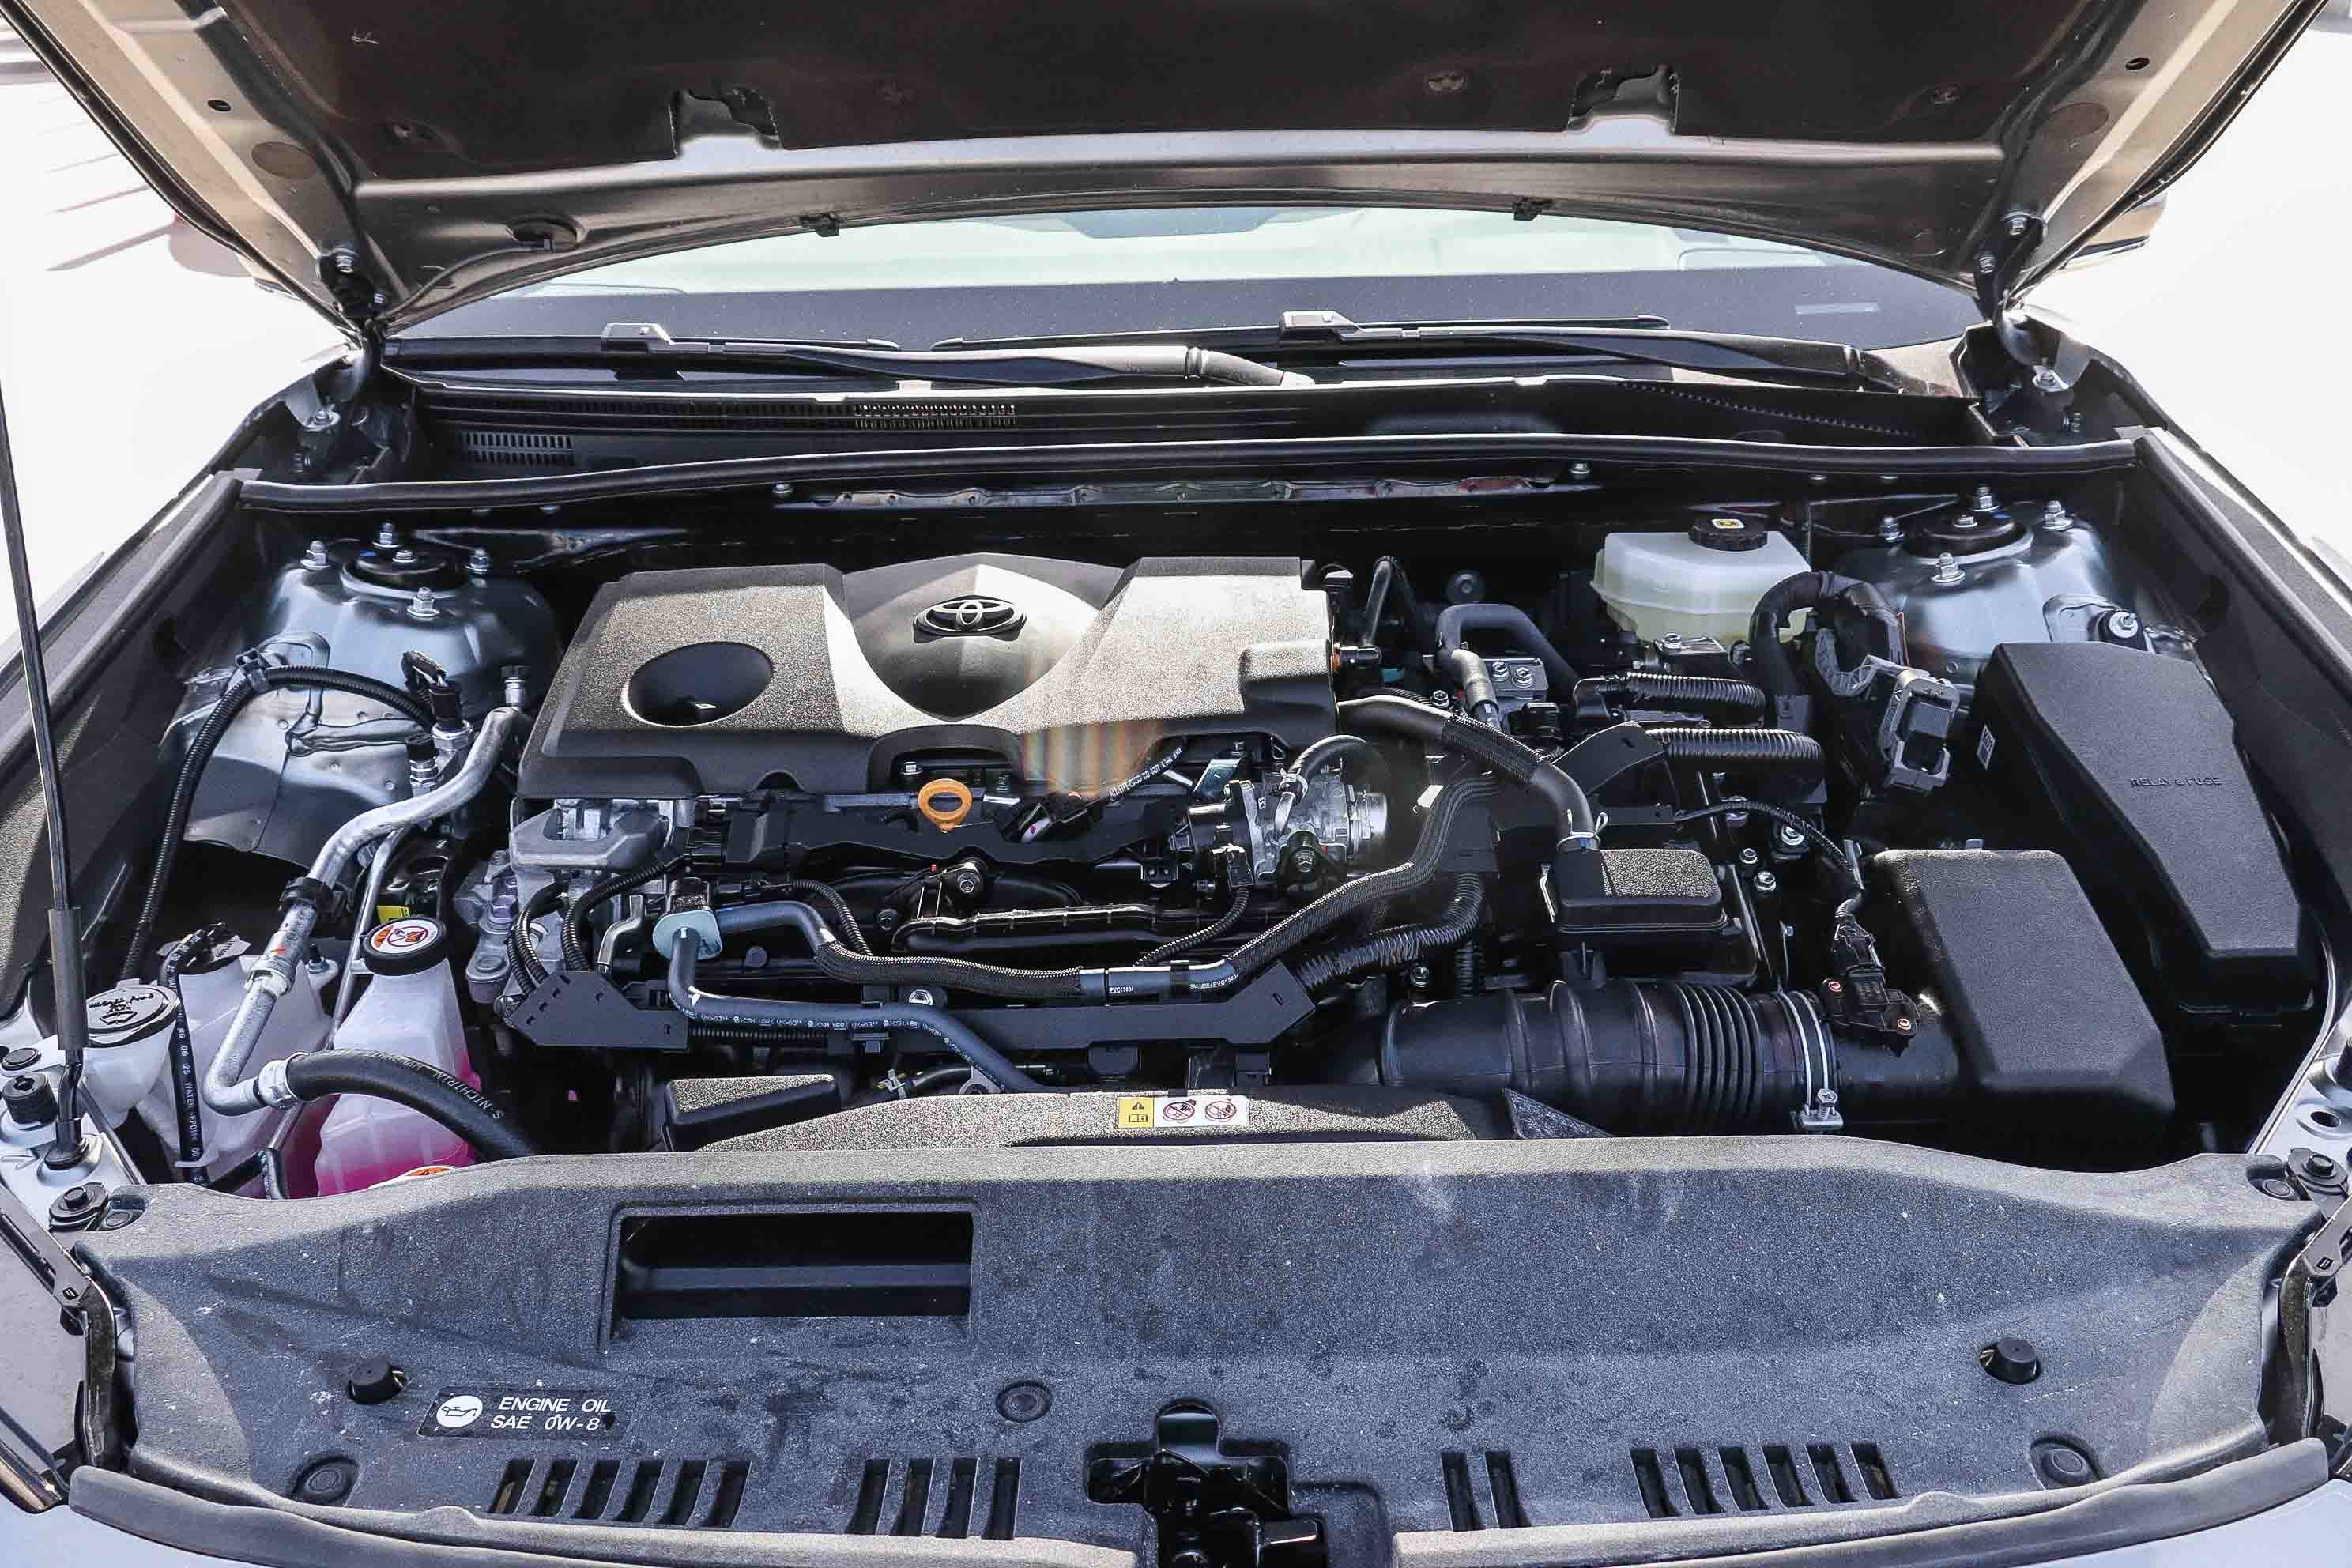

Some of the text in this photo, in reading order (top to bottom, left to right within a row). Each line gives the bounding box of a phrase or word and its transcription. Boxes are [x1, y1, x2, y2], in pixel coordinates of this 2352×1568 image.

[2130, 778, 2174, 788] RELAY
[2186, 777, 2222, 786] FUSE
[498, 1396, 612, 1412] ENGINE OIL
[490, 1415, 601, 1430] SAE 0W-8
